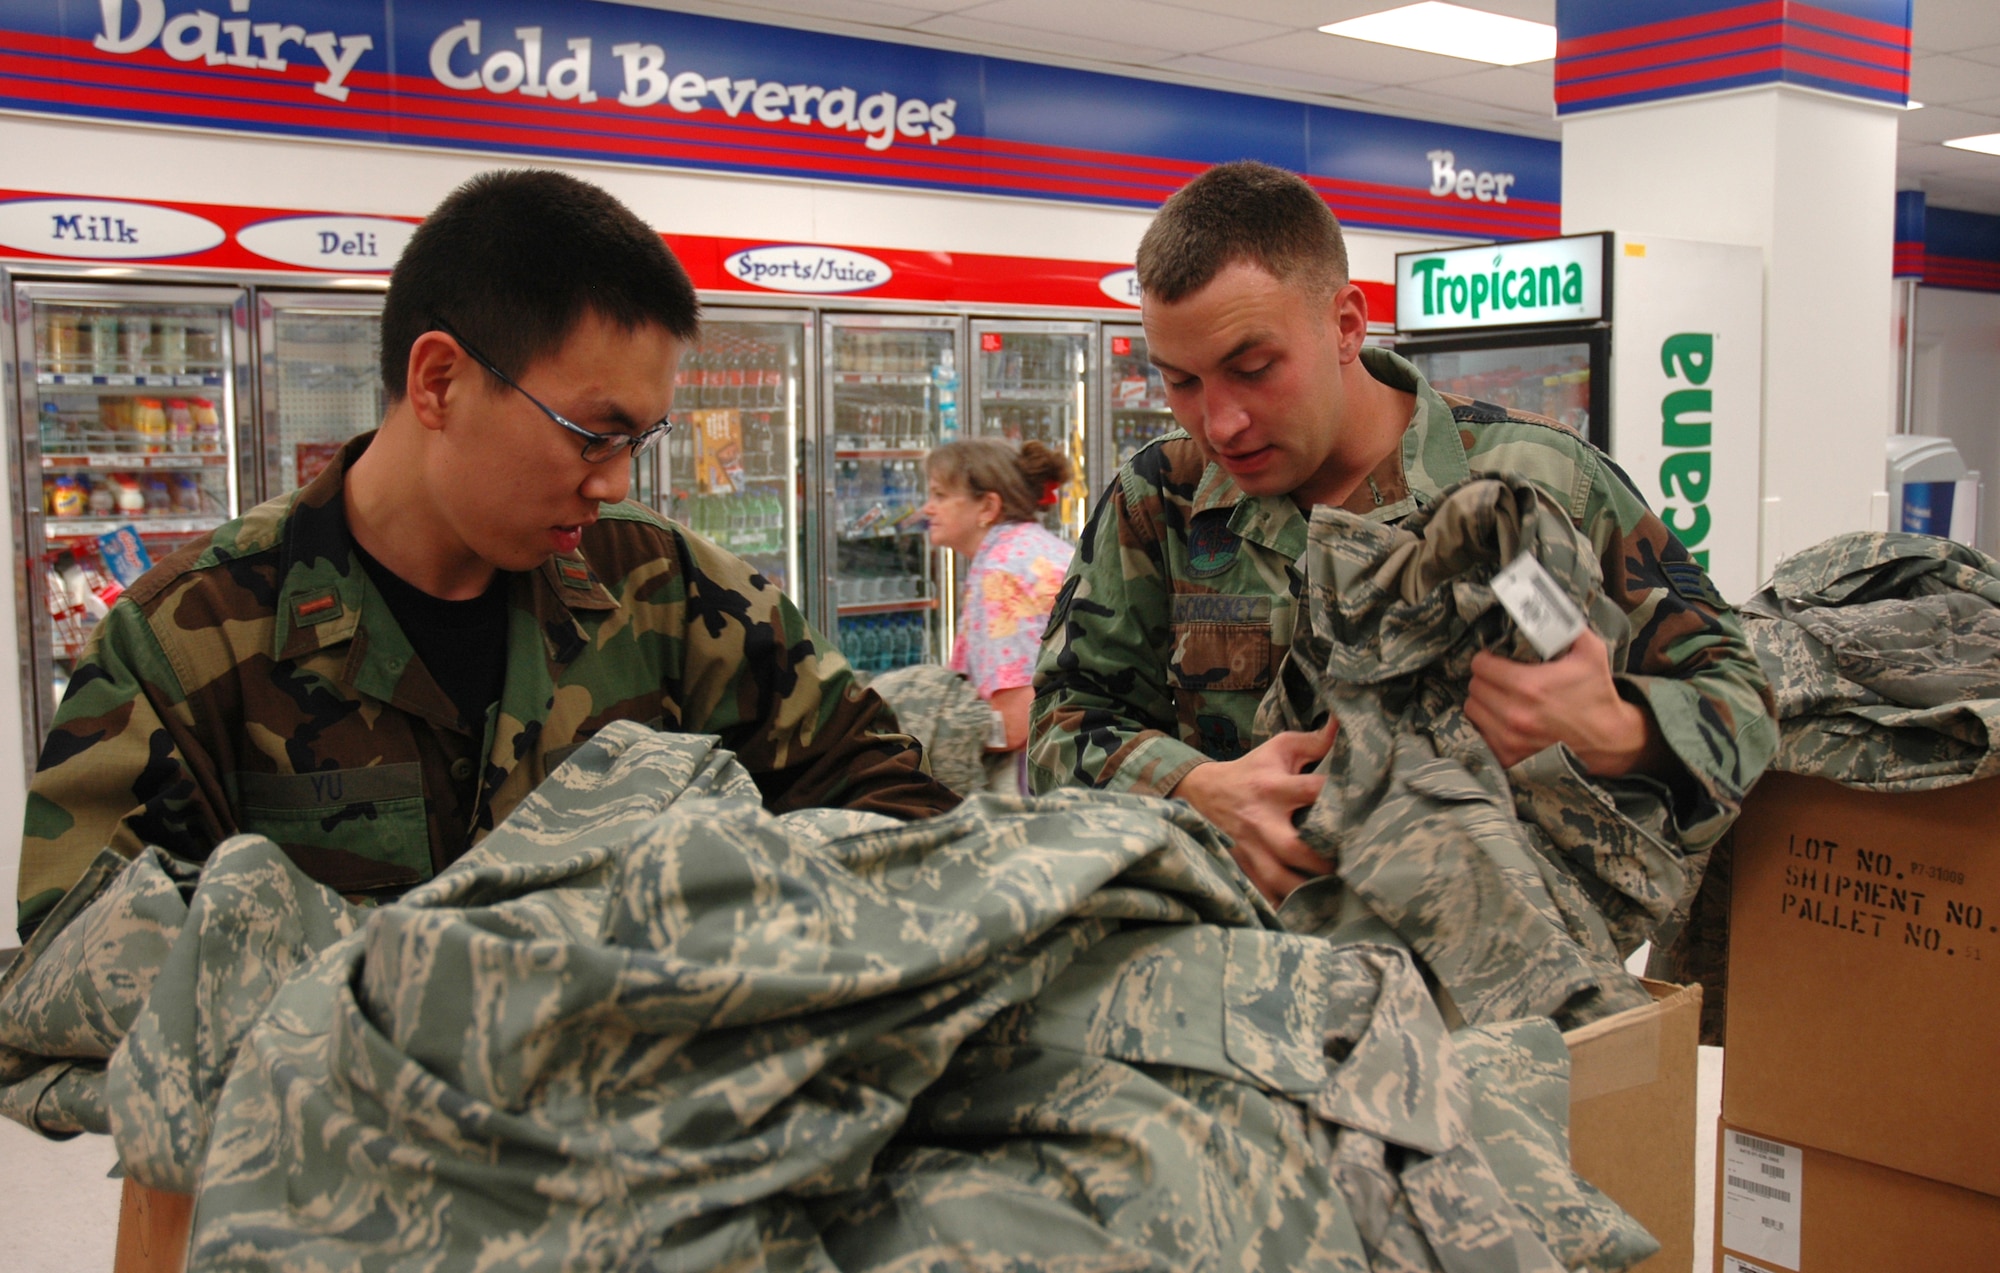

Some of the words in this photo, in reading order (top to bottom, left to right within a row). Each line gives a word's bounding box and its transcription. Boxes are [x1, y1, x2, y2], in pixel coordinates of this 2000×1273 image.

[93, 0, 373, 102] Dairy
[429, 19, 598, 104] Cold
[611, 42, 957, 150] Beverages
[1426, 149, 1515, 204] Beer
[51, 213, 139, 245] Milk
[317, 230, 379, 258] Deli
[738, 253, 877, 282] Sports/Juice
[1411, 255, 1583, 320] Tropicana
[310, 773, 344, 802] YU
[1789, 834, 1838, 864] LOT
[1857, 848, 1904, 880] NO.
[1782, 893, 1886, 938] PALLET
[1905, 921, 1955, 956] NO.
[1785, 864, 1926, 916] SHIPMENT
[1946, 900, 1998, 934] NO.
